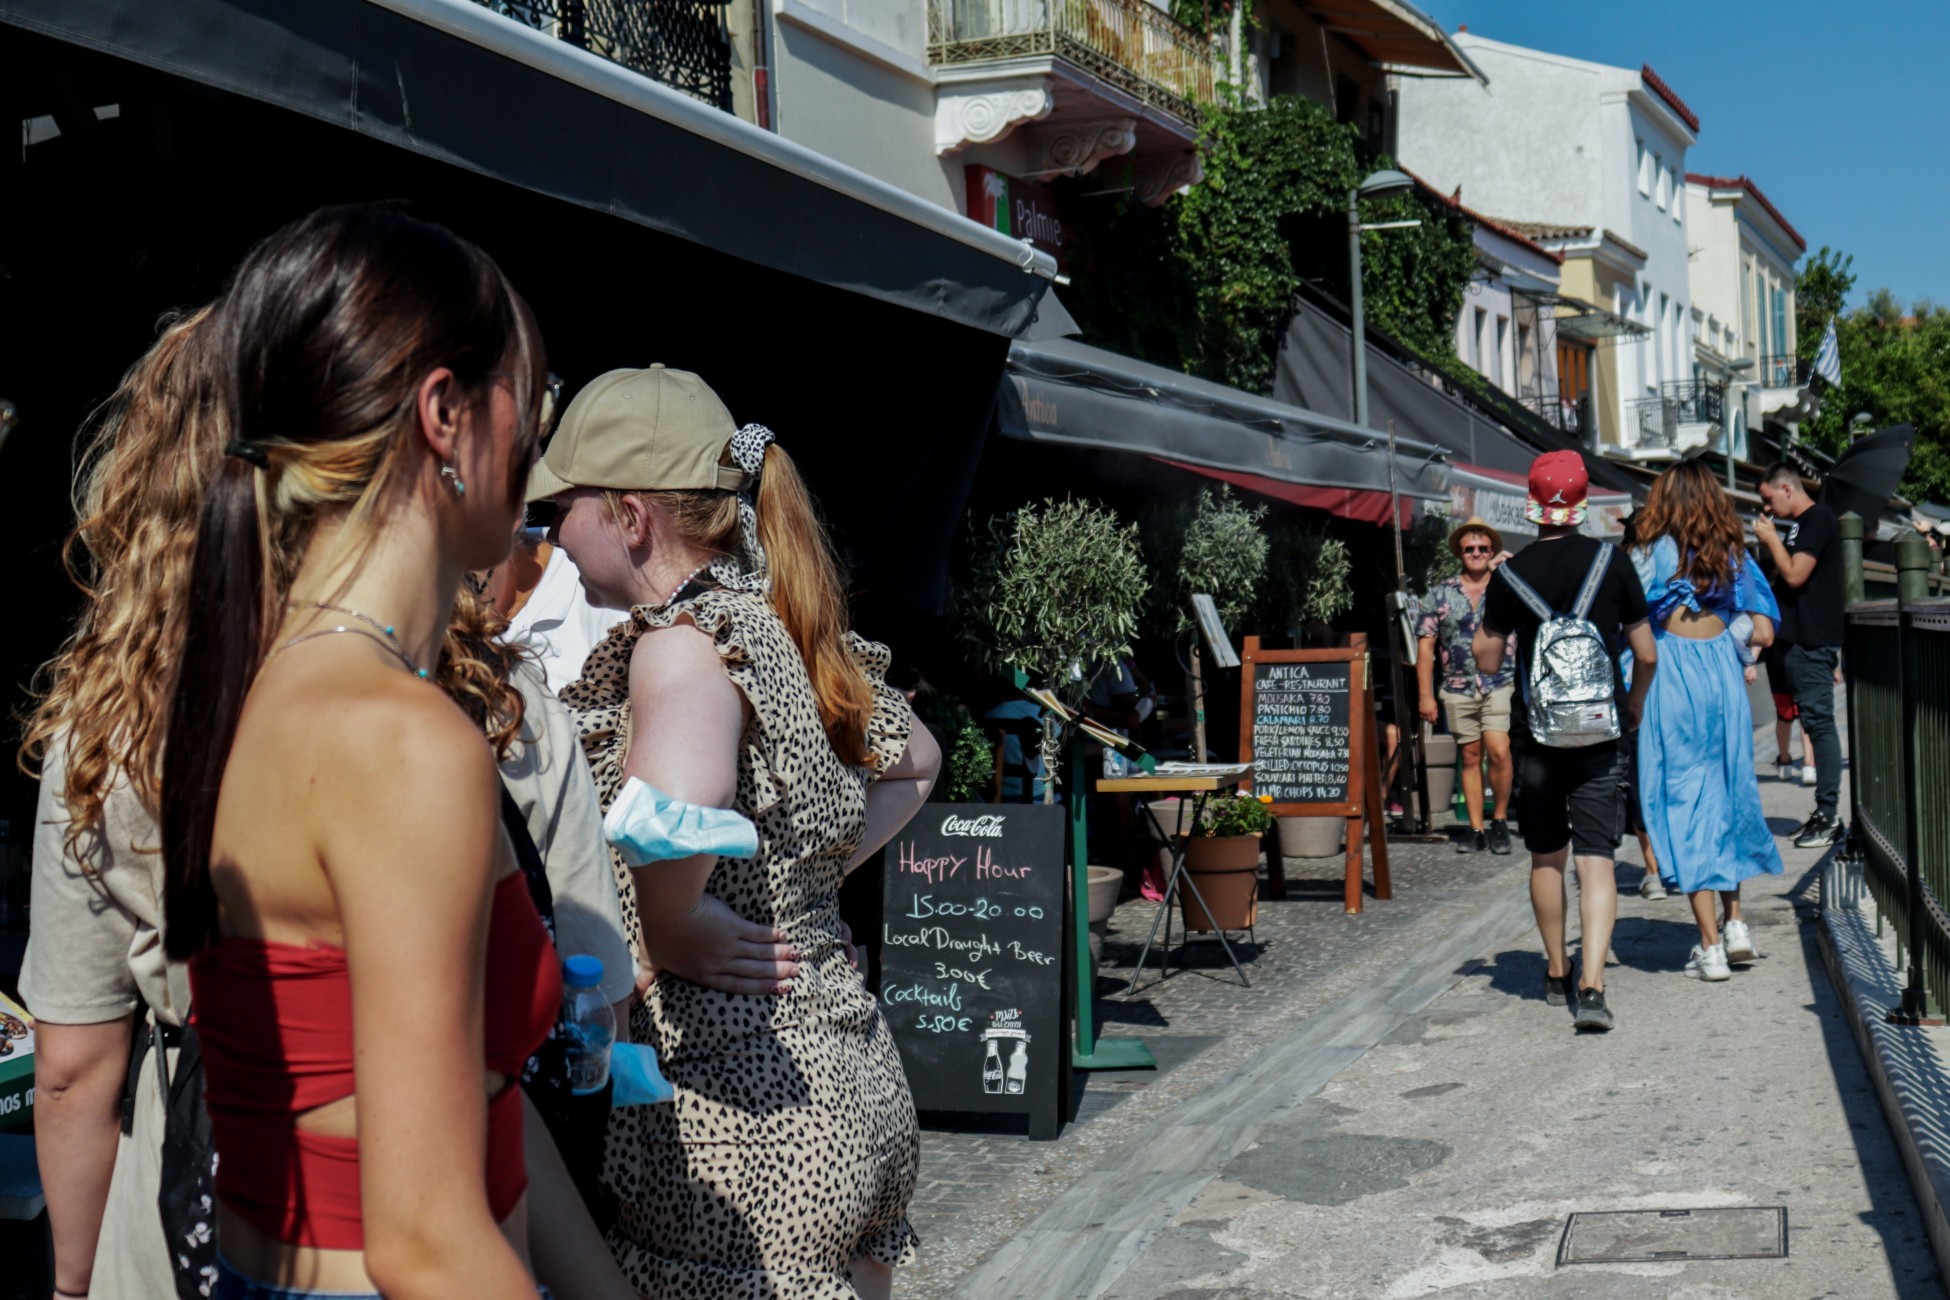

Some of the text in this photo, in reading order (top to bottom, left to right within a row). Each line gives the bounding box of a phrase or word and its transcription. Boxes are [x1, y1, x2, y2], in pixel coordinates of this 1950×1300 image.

[1016, 199, 1062, 246] Palmie
[1269, 666, 1309, 679] ANTICA
[1258, 693, 1305, 704] MOUSAKA
[1257, 704, 1307, 715] PASTICHIO
[1256, 715, 1306, 725] CALAMARI
[1307, 725, 1331, 736] SAUCE
[1254, 736, 1279, 747] FRESH
[1281, 736, 1321, 748] SARDINES
[1254, 747, 1302, 758] VEGETERIAN
[1303, 748, 1337, 759] MOUSAKA
[1254, 759, 1290, 771] GRILLED
[1291, 761, 1329, 773] OCTOPUS
[1255, 784, 1282, 798] LAMB
[1284, 786, 1313, 798] CHOPS
[941, 814, 1006, 838] Coca-Cola
[900, 840, 1032, 884] Happy Hour
[884, 923, 1055, 965] Local Draught Beer
[884, 982, 961, 1011] Cocktails
